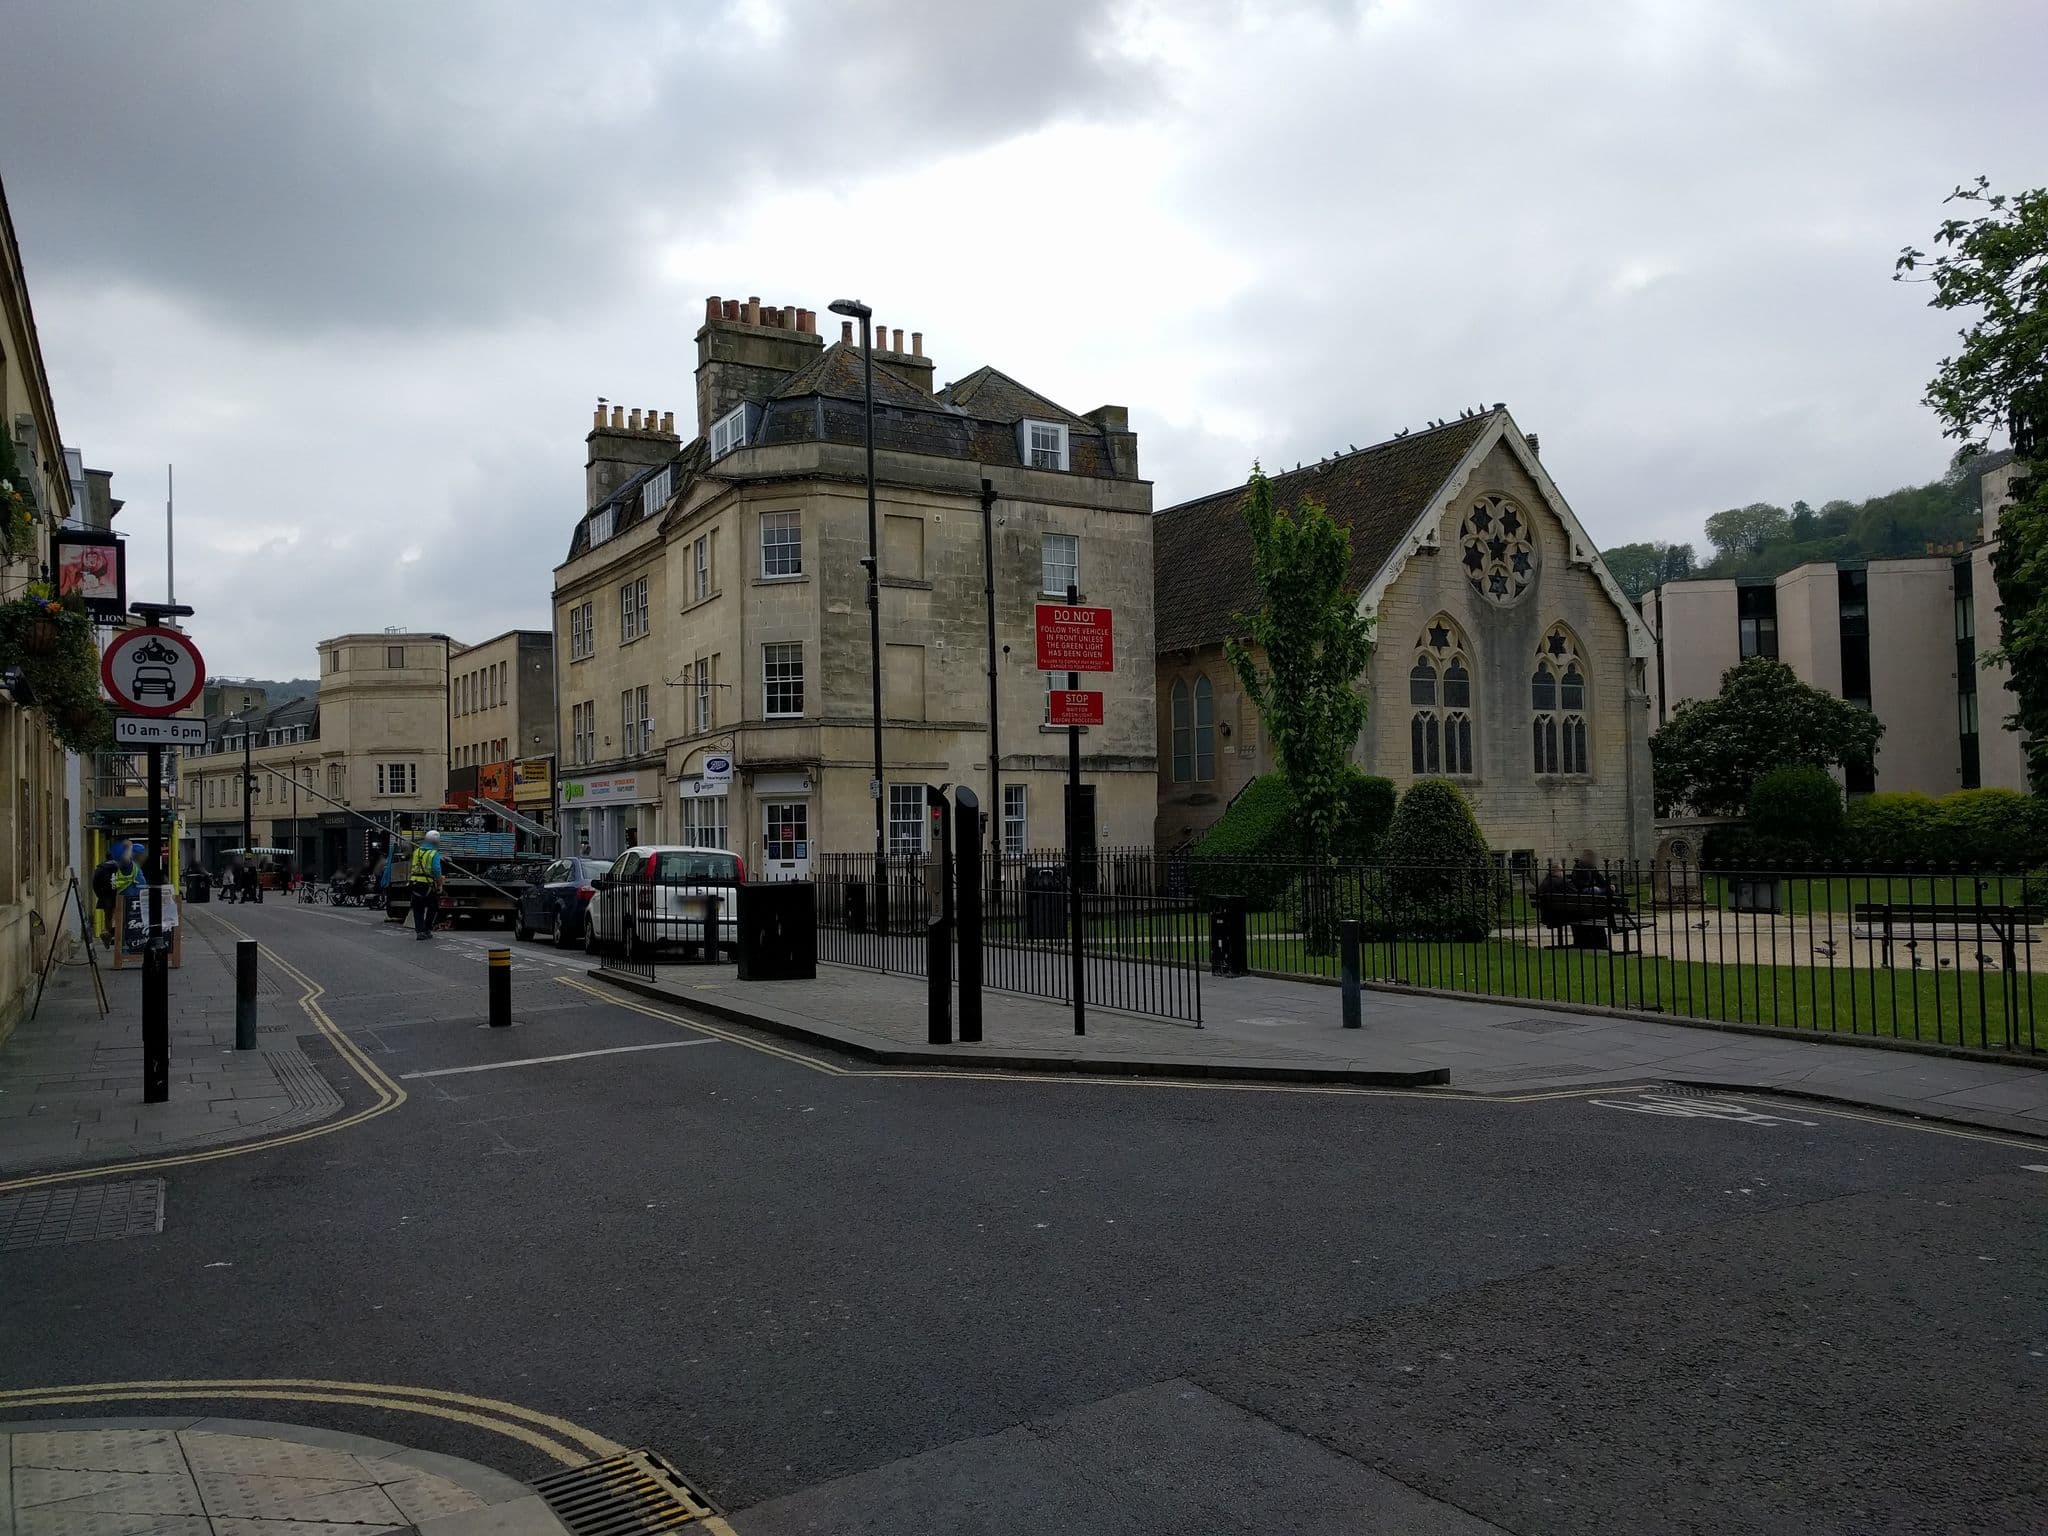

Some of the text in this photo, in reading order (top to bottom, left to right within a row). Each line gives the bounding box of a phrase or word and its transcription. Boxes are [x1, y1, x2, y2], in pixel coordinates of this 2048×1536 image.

[99, 614, 124, 623] LION
[1054, 610, 1096, 622] DO NOT
[1040, 625, 1067, 633] FOLLOW
[1082, 628, 1109, 636] VEHICLE
[1056, 634, 1077, 642] FRONT
[1078, 635, 1104, 643] UNLESS
[1062, 642, 1083, 650] GREEN
[1085, 643, 1103, 651] LIGHT
[1082, 650, 1103, 658] GIVEN
[1065, 693, 1089, 703] STOP
[120, 723, 137, 735] 10
[140, 726, 160, 736] am
[170, 725, 179, 737] 6
[182, 727, 202, 739] pm
